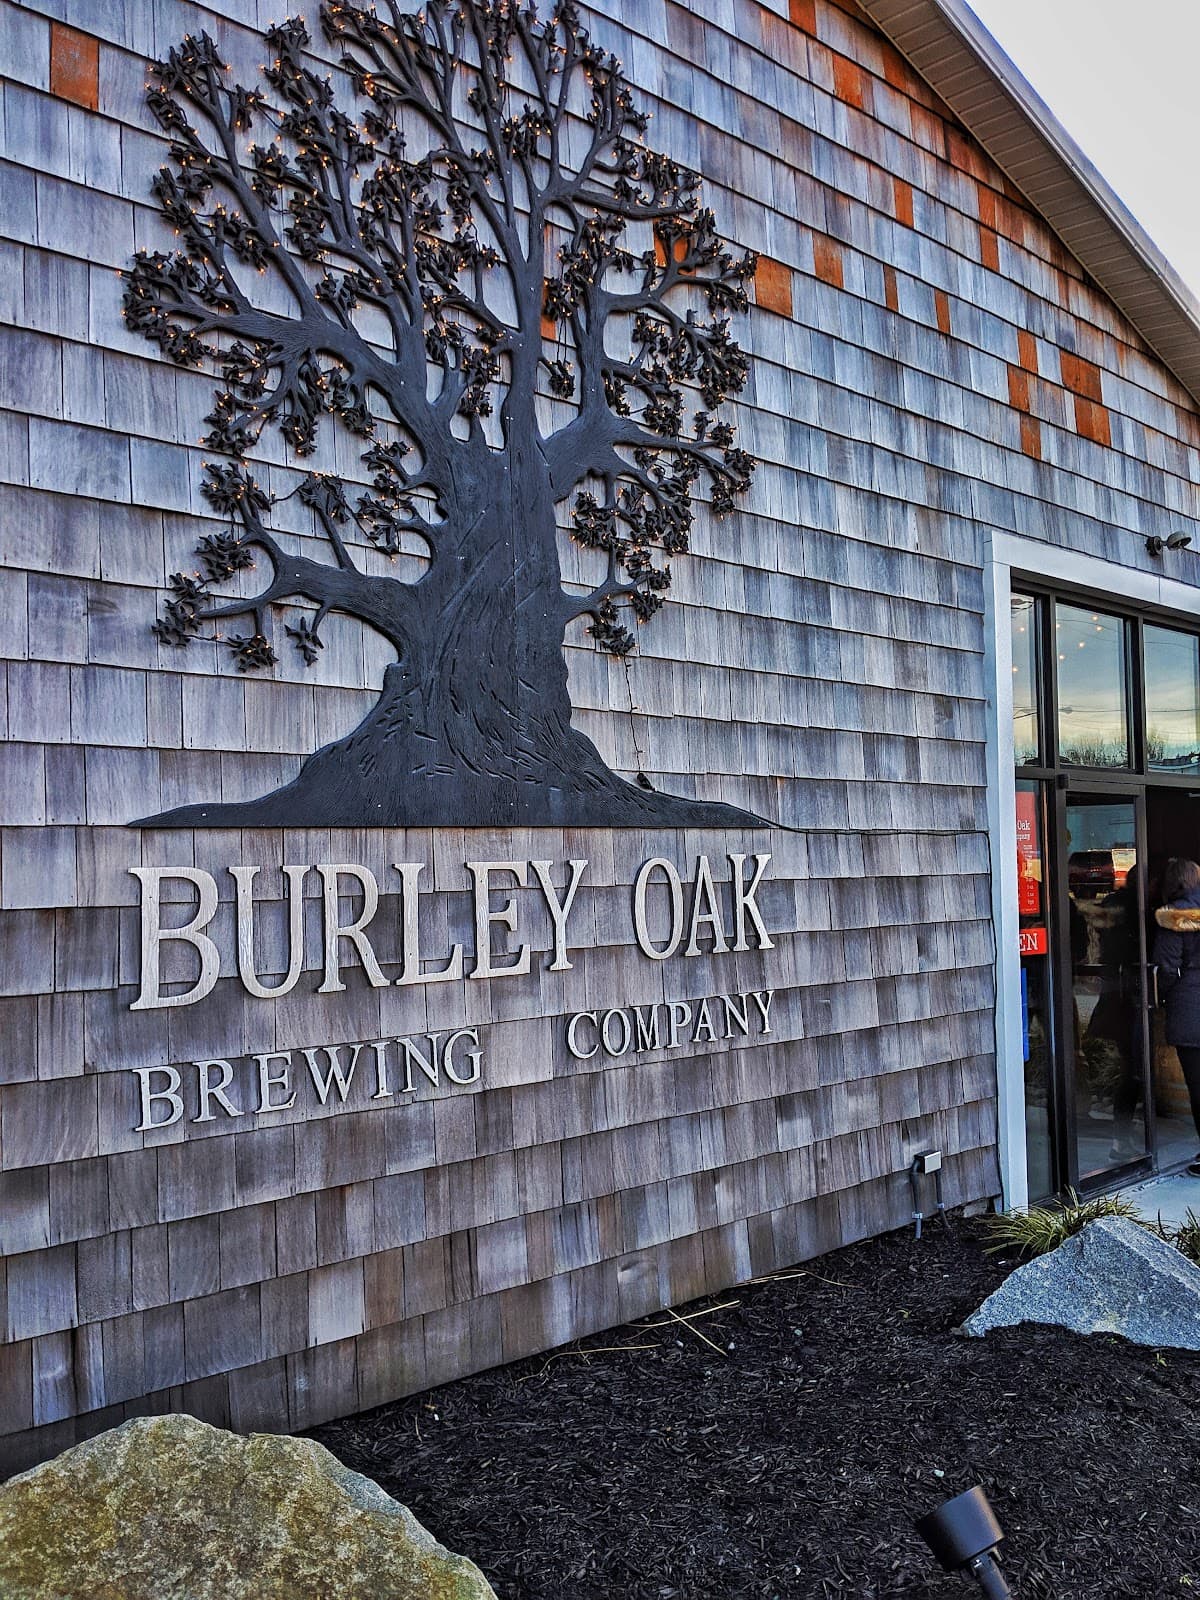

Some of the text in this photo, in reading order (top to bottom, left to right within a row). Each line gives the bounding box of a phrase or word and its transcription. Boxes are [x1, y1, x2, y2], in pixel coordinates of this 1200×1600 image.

[1017, 819, 1031, 830] Oak
[128, 853, 775, 1011] BURLEY OAK
[132, 990, 774, 1132] BREWING COMPANY
